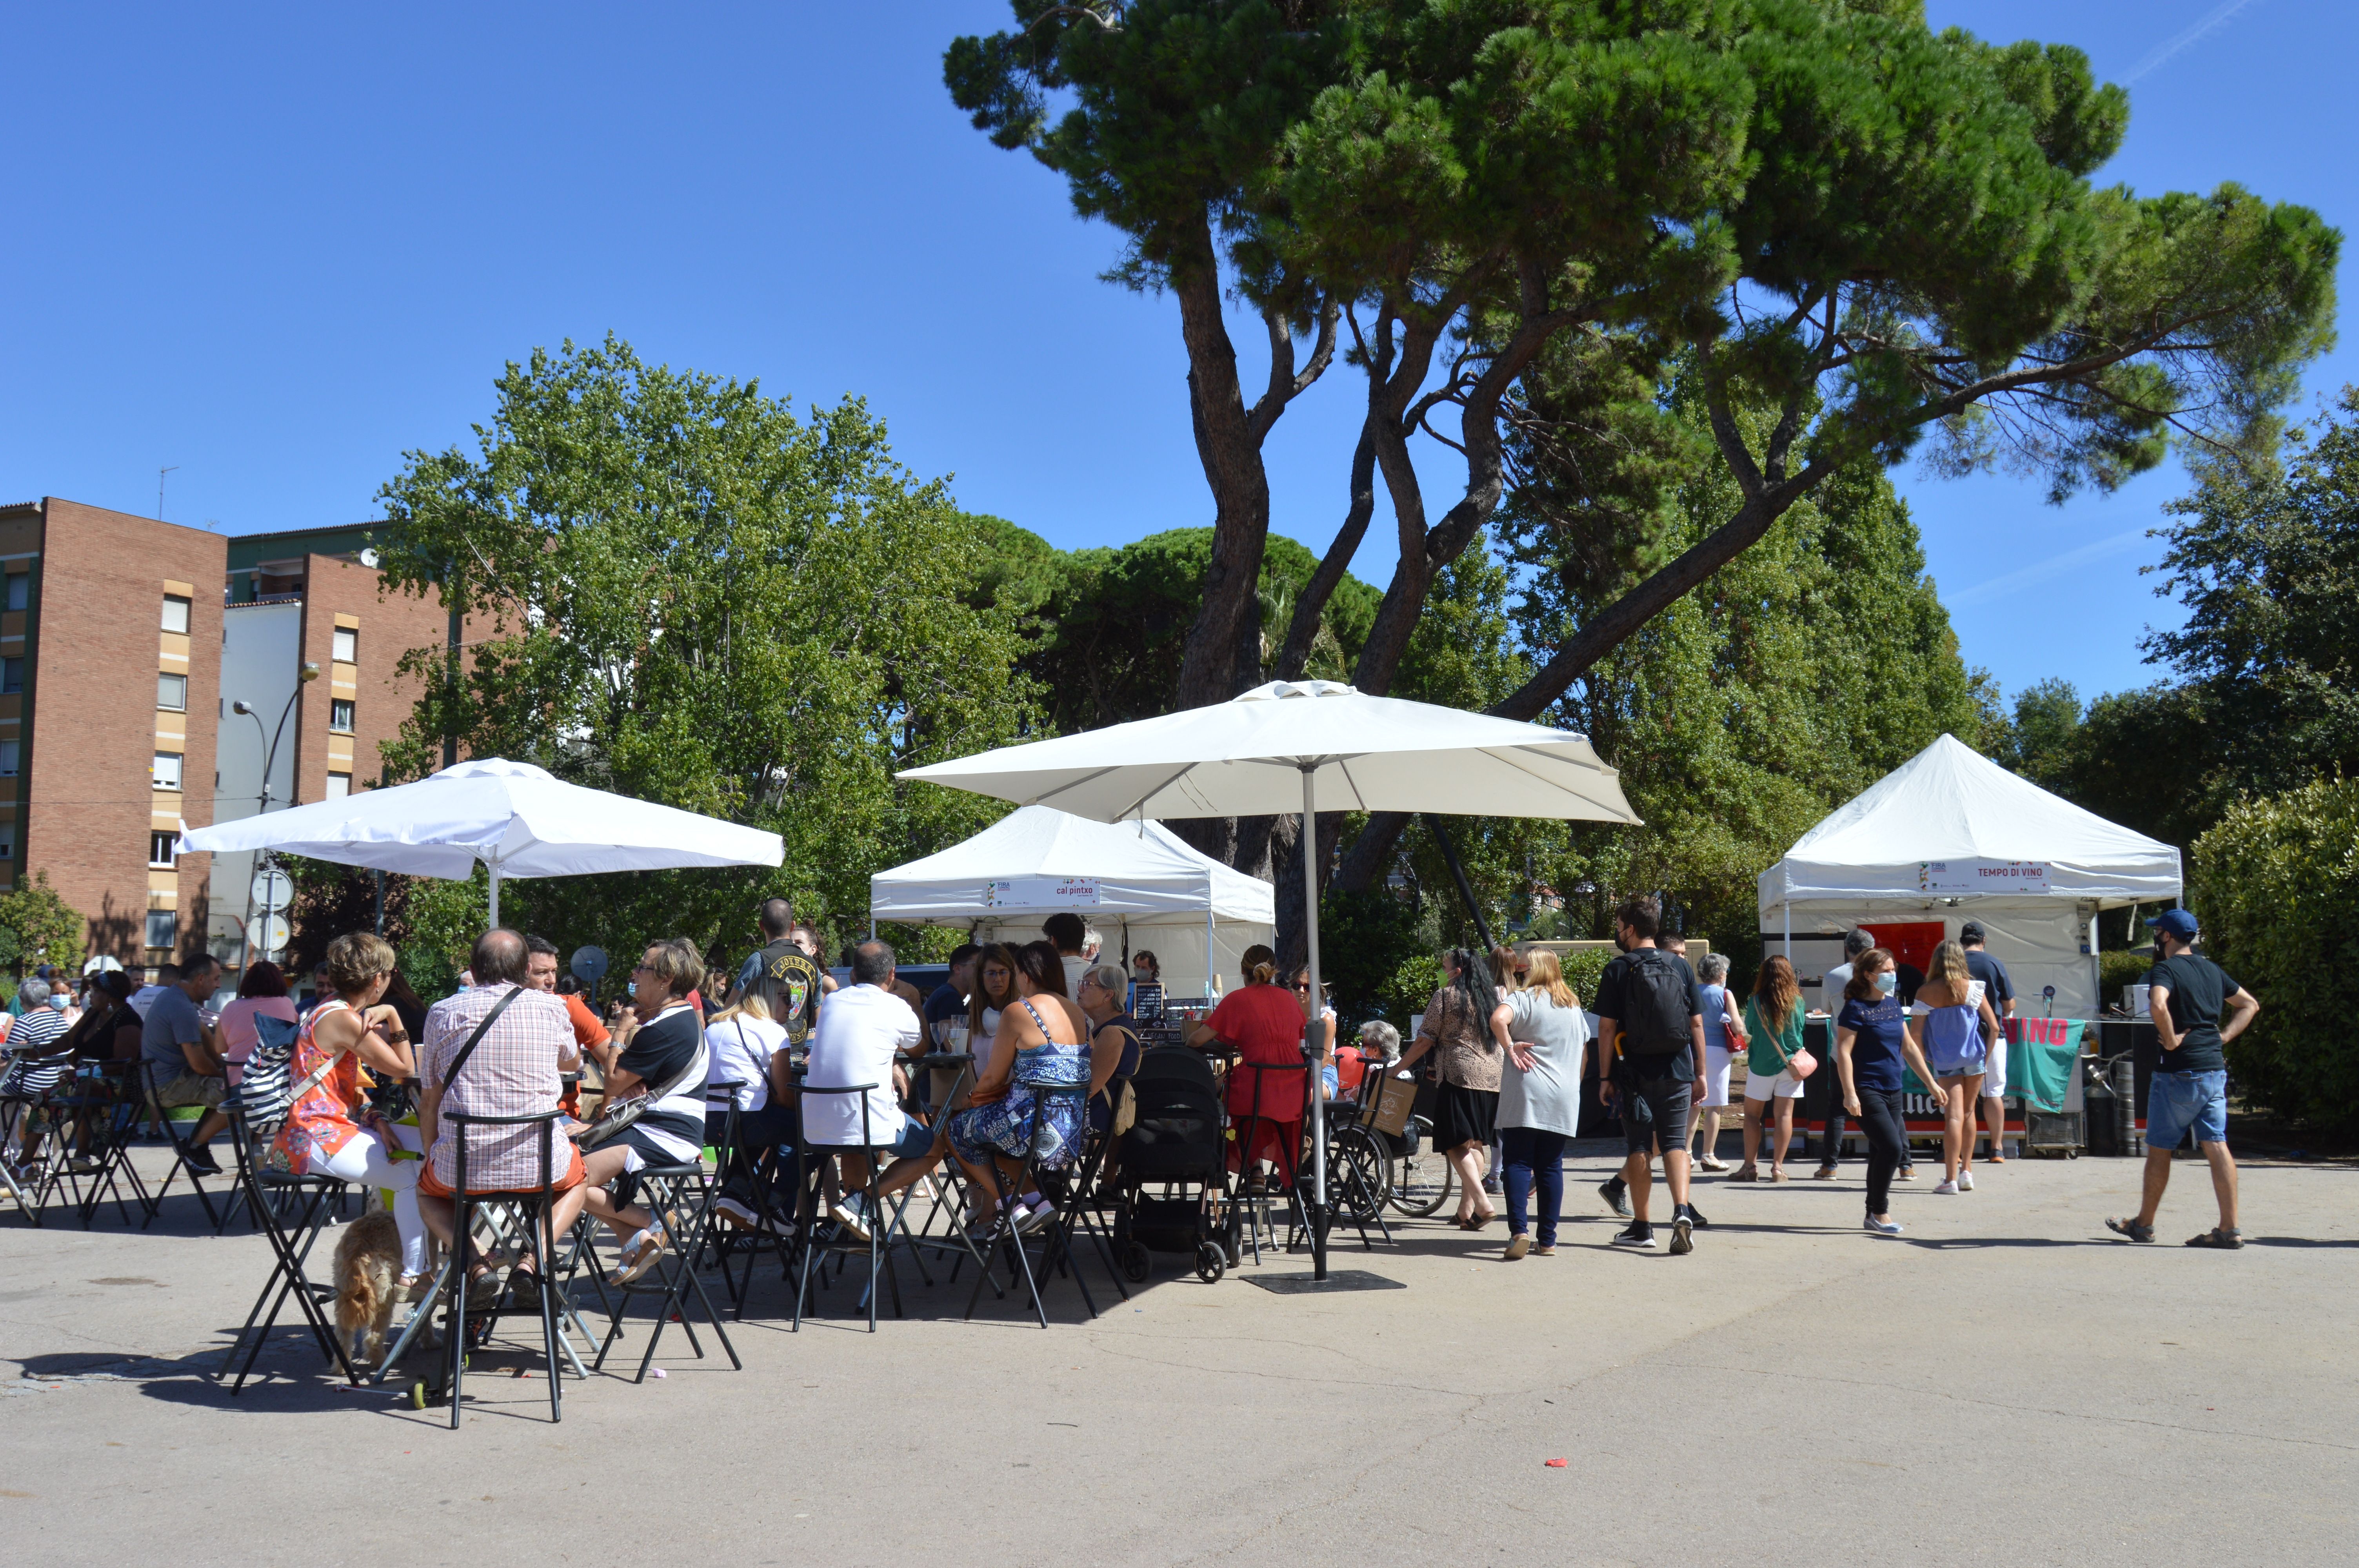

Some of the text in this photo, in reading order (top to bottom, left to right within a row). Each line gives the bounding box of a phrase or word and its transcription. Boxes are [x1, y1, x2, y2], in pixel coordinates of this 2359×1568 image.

[1070, 886, 1092, 896] pintxo
[780, 958, 812, 973] JOKERS
[2002, 1018, 2068, 1046] VINO
